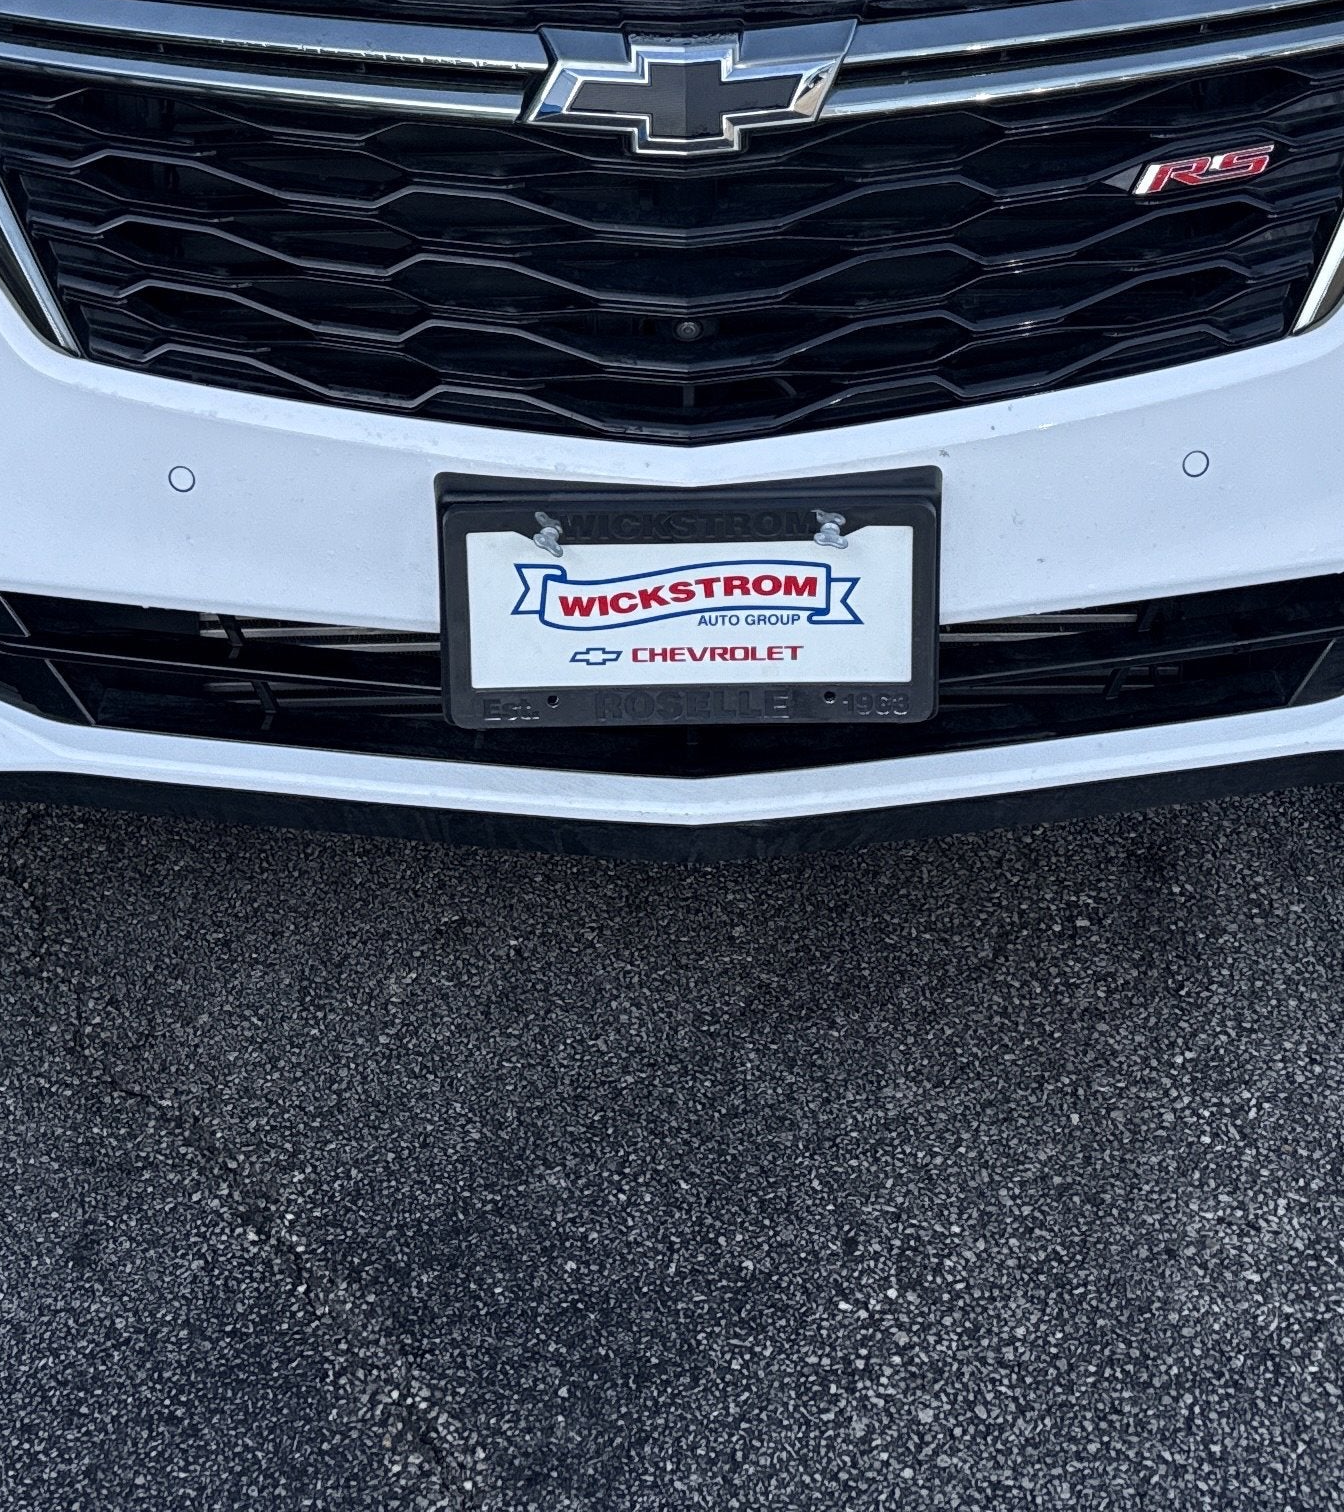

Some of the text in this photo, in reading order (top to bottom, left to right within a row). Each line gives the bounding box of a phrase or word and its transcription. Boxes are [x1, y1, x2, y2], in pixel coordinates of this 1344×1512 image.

[1133, 143, 1275, 196] RS
[559, 512, 816, 540] WICKSTROM
[558, 574, 818, 618] WICKSTROM
[697, 614, 801, 627] AUTO GROUP
[632, 645, 805, 663] CHEVROLET
[594, 690, 790, 720] ROSELLE
